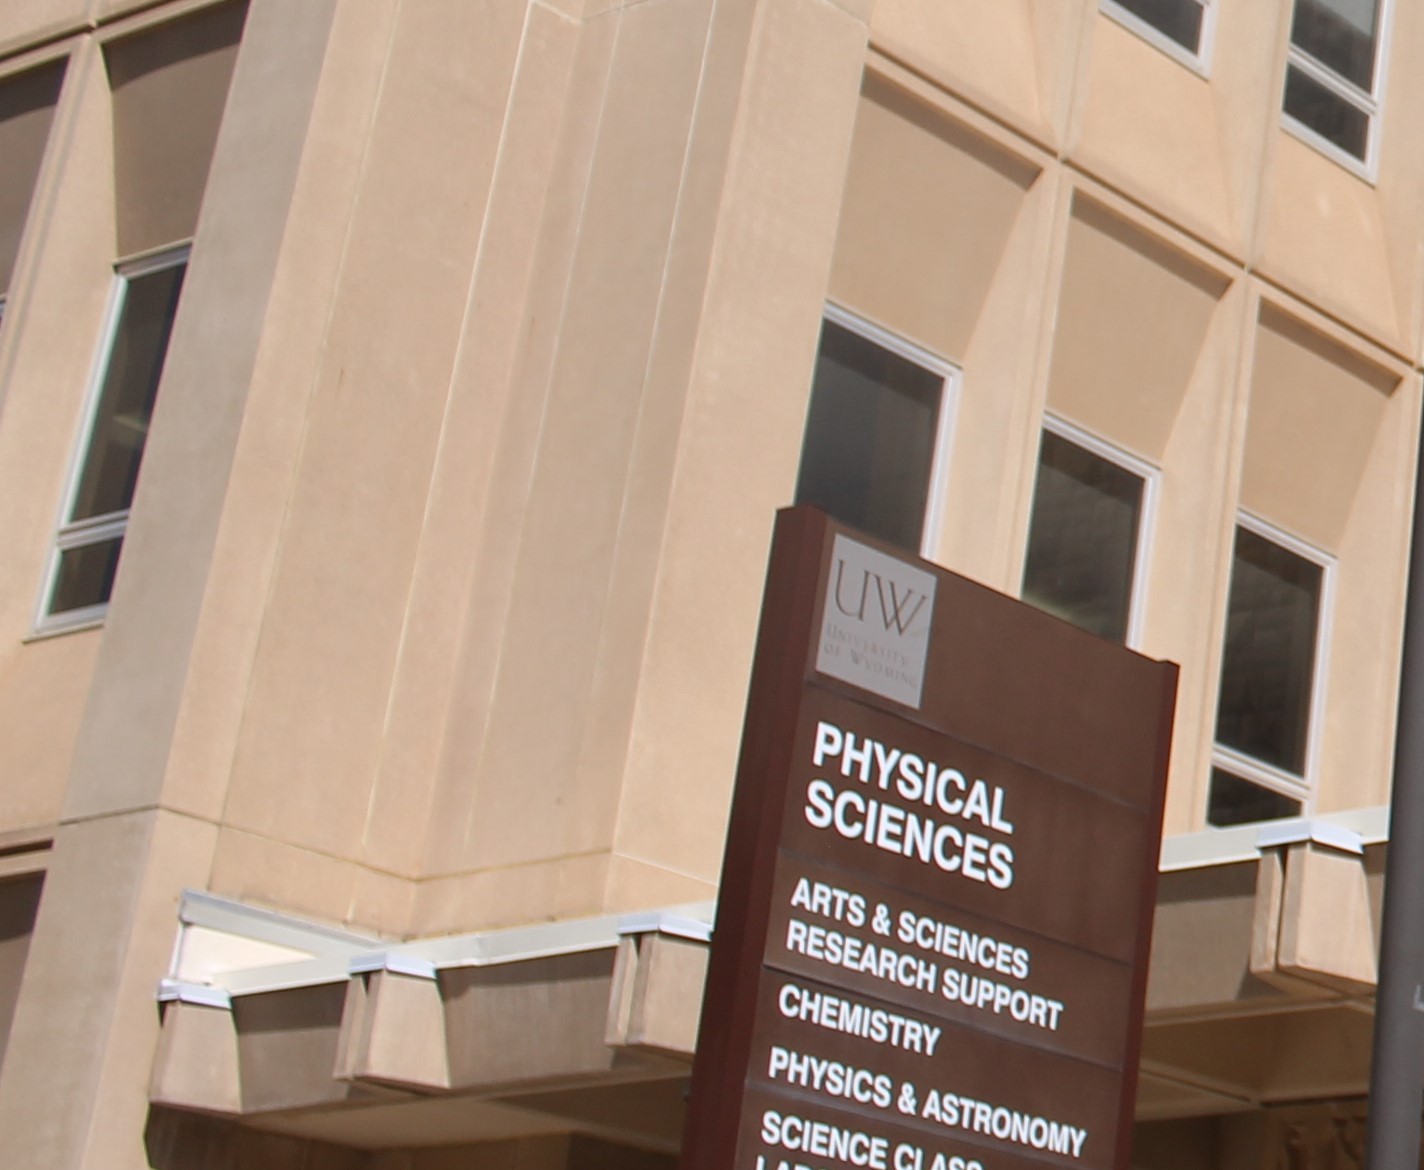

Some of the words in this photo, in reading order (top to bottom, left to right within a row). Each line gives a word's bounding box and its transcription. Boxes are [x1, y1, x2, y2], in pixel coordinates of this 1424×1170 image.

[833, 558, 928, 638] UW
[826, 622, 906, 667] UNIVERSITY
[848, 646, 918, 686] WYOMING
[812, 721, 1014, 834] PHYSICAL
[804, 779, 1014, 889] SCIENCES
[790, 877, 866, 927] ARTS
[871, 903, 891, 937] &
[897, 911, 1029, 979] SCIENCES
[778, 984, 941, 1056] CHEMISTRY
[786, 919, 937, 994] RESEARCH
[941, 968, 1064, 1031] SUPPORT
[761, 1110, 889, 1170] SCIENCE
[768, 1046, 892, 1108] PHYSICS
[897, 1082, 917, 1116] &
[921, 1089, 1087, 1158] ASTRONOMY
